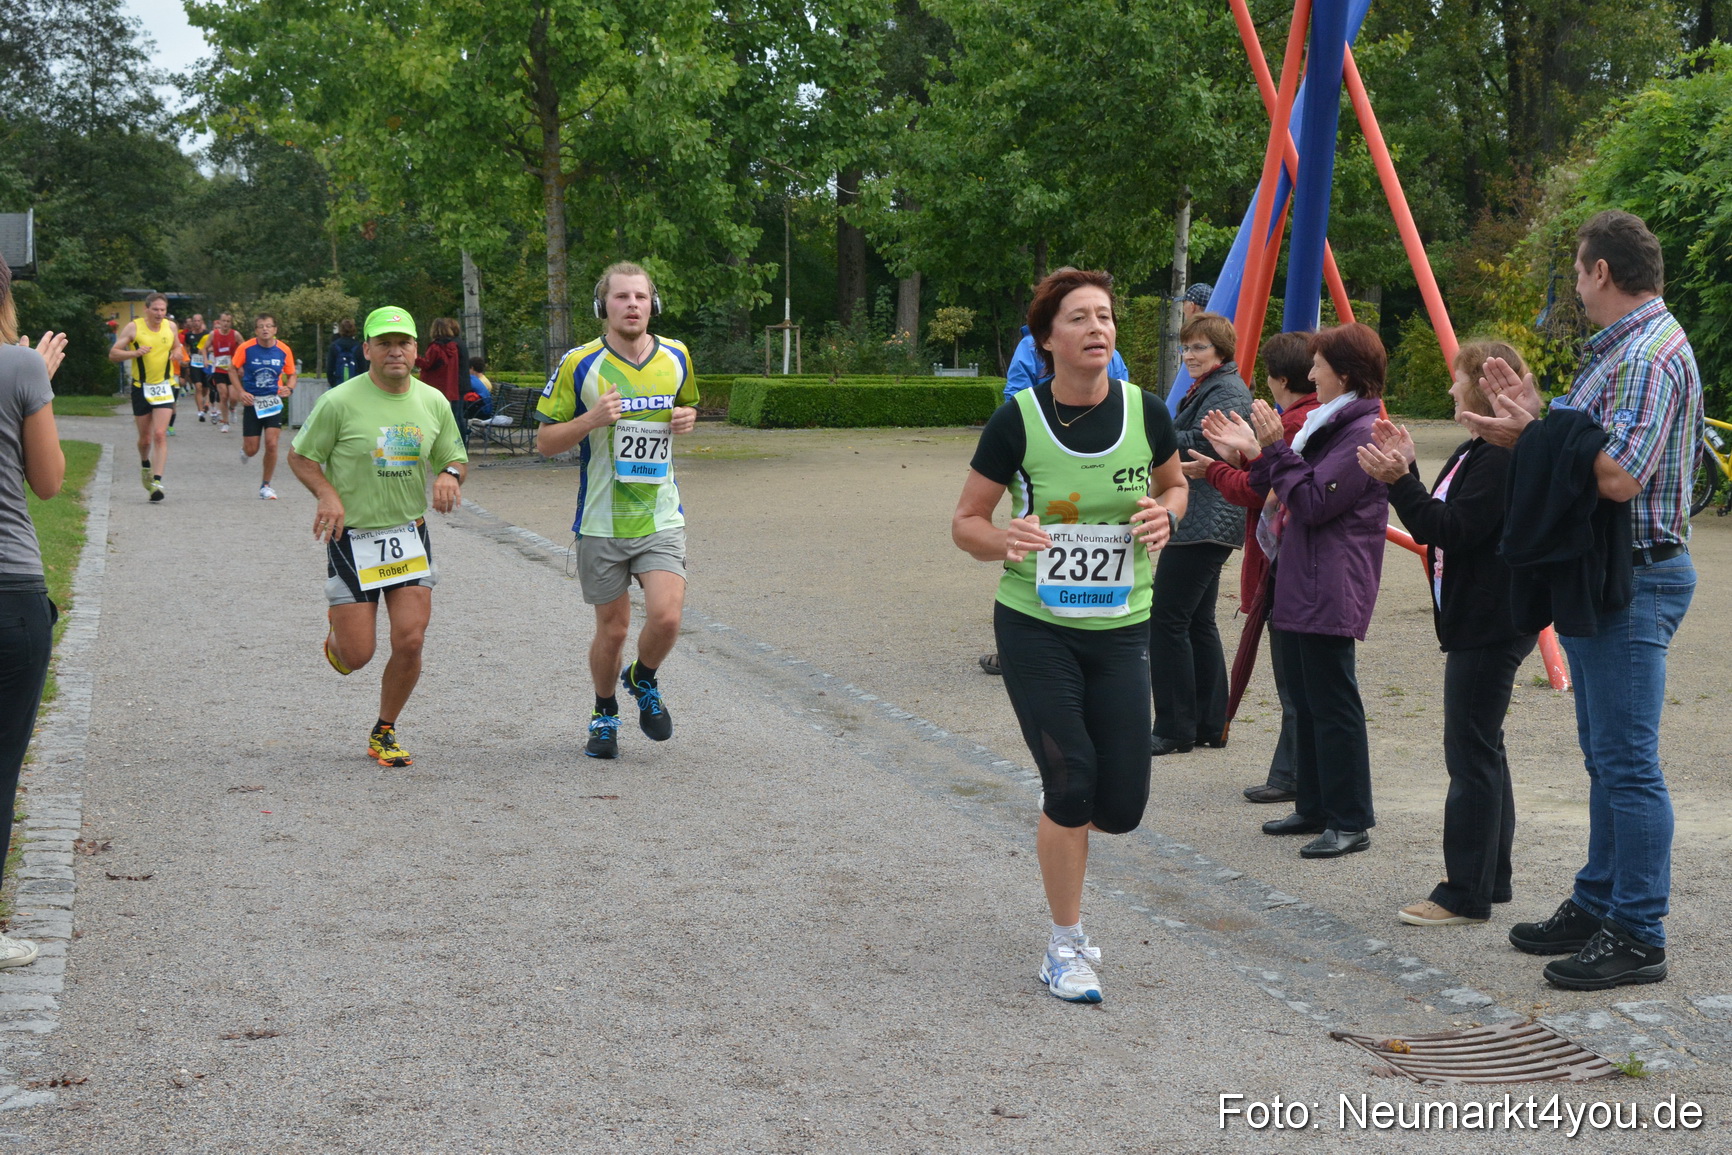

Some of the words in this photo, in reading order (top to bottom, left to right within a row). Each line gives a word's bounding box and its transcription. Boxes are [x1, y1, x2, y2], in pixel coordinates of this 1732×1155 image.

[150, 386, 167, 396] 324
[620, 384, 657, 395] EAM
[620, 395, 676, 413] BOCK
[616, 425, 639, 433] PARTL
[620, 435, 669, 460] 2873
[377, 469, 412, 478] SIEMENS
[630, 465, 657, 475] Arthur
[1113, 466, 1145, 484] CIS
[375, 527, 406, 537] Neumarkt
[1049, 533, 1074, 542] ARTL
[1076, 533, 1122, 543] Neumarkt
[374, 537, 404, 562] 78
[1048, 546, 1127, 582] 2327
[379, 563, 409, 578] Robert
[1059, 590, 1114, 604] Gertraud
